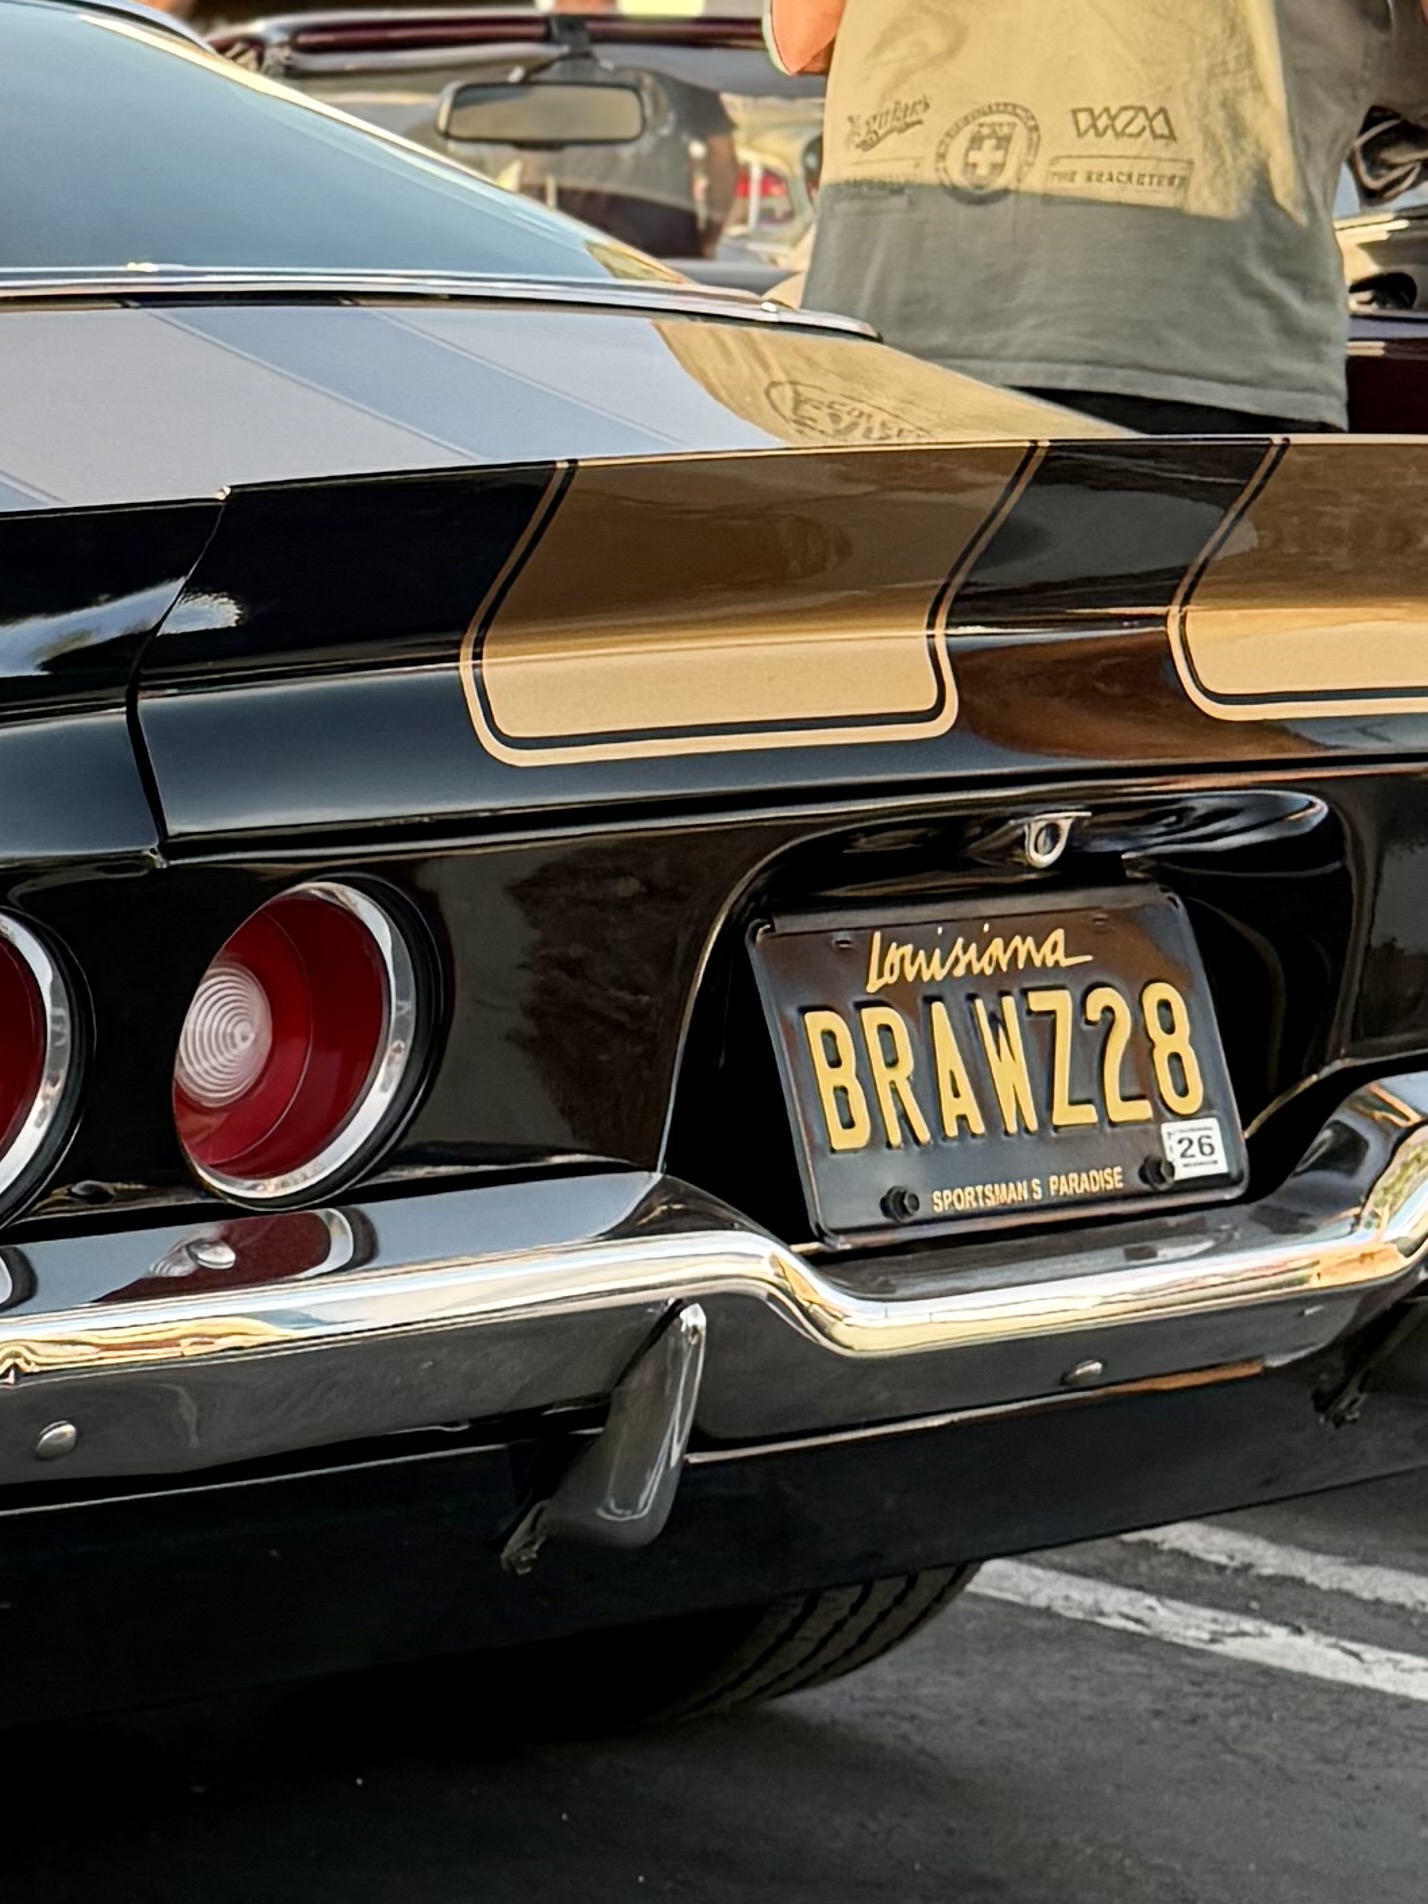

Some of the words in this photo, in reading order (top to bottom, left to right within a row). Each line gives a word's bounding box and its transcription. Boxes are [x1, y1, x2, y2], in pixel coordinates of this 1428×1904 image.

[865, 922, 1093, 994] Louisiana
[804, 981, 1205, 1152] BRAWZ28
[1176, 1134, 1216, 1159] 26
[1049, 1165, 1124, 1197] PARADISE
